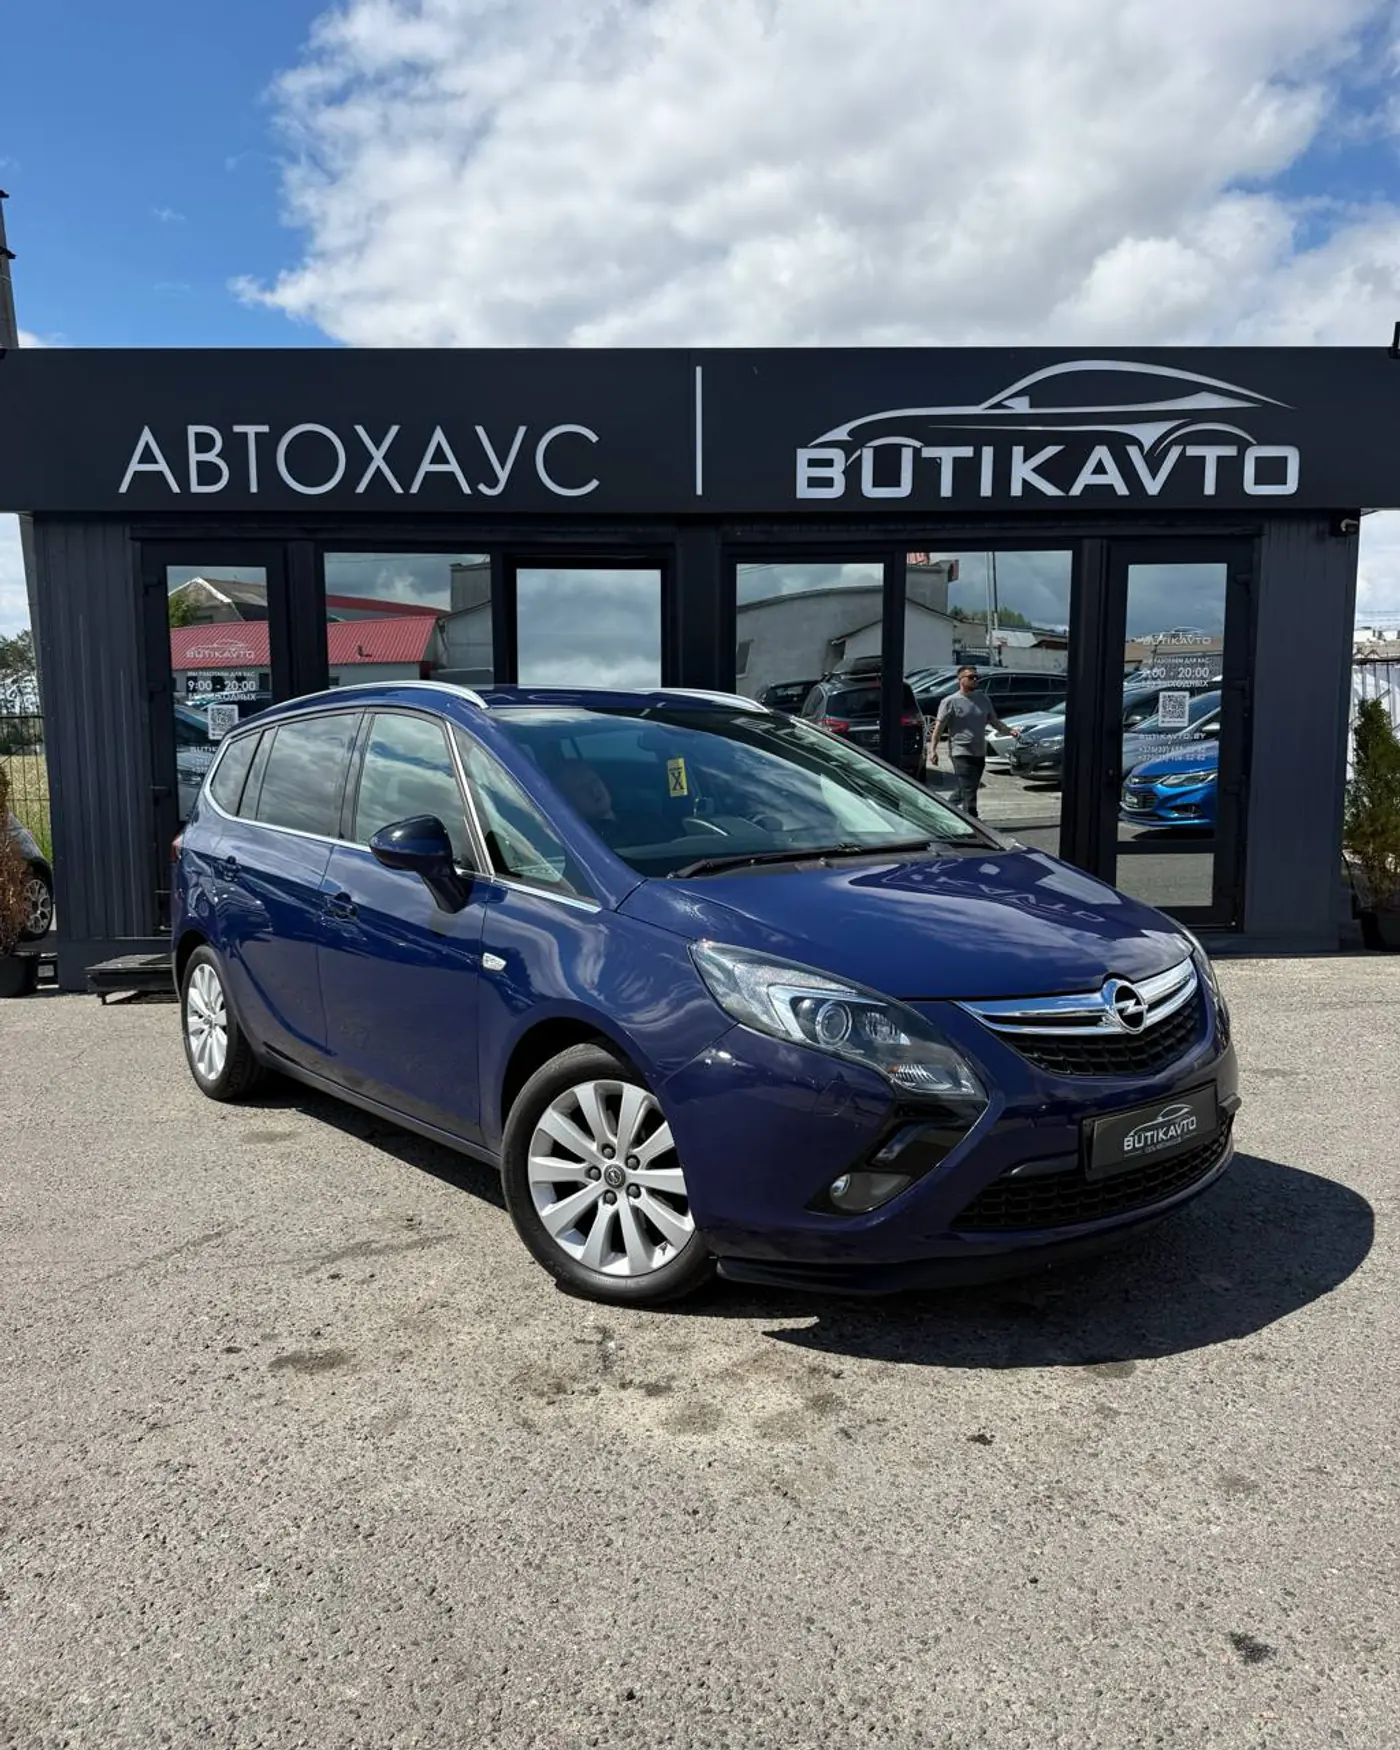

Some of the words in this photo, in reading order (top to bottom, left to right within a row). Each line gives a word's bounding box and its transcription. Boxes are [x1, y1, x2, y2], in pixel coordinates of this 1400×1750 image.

[118, 423, 601, 497] АВТОХАУС
[796, 444, 1301, 499] BUTIKAVTO
[187, 680, 213, 691] 9:00
[224, 680, 256, 692] 20:00
[1178, 667, 1210, 678] 20:00
[1123, 1116, 1197, 1151] BUTIKAVTO
